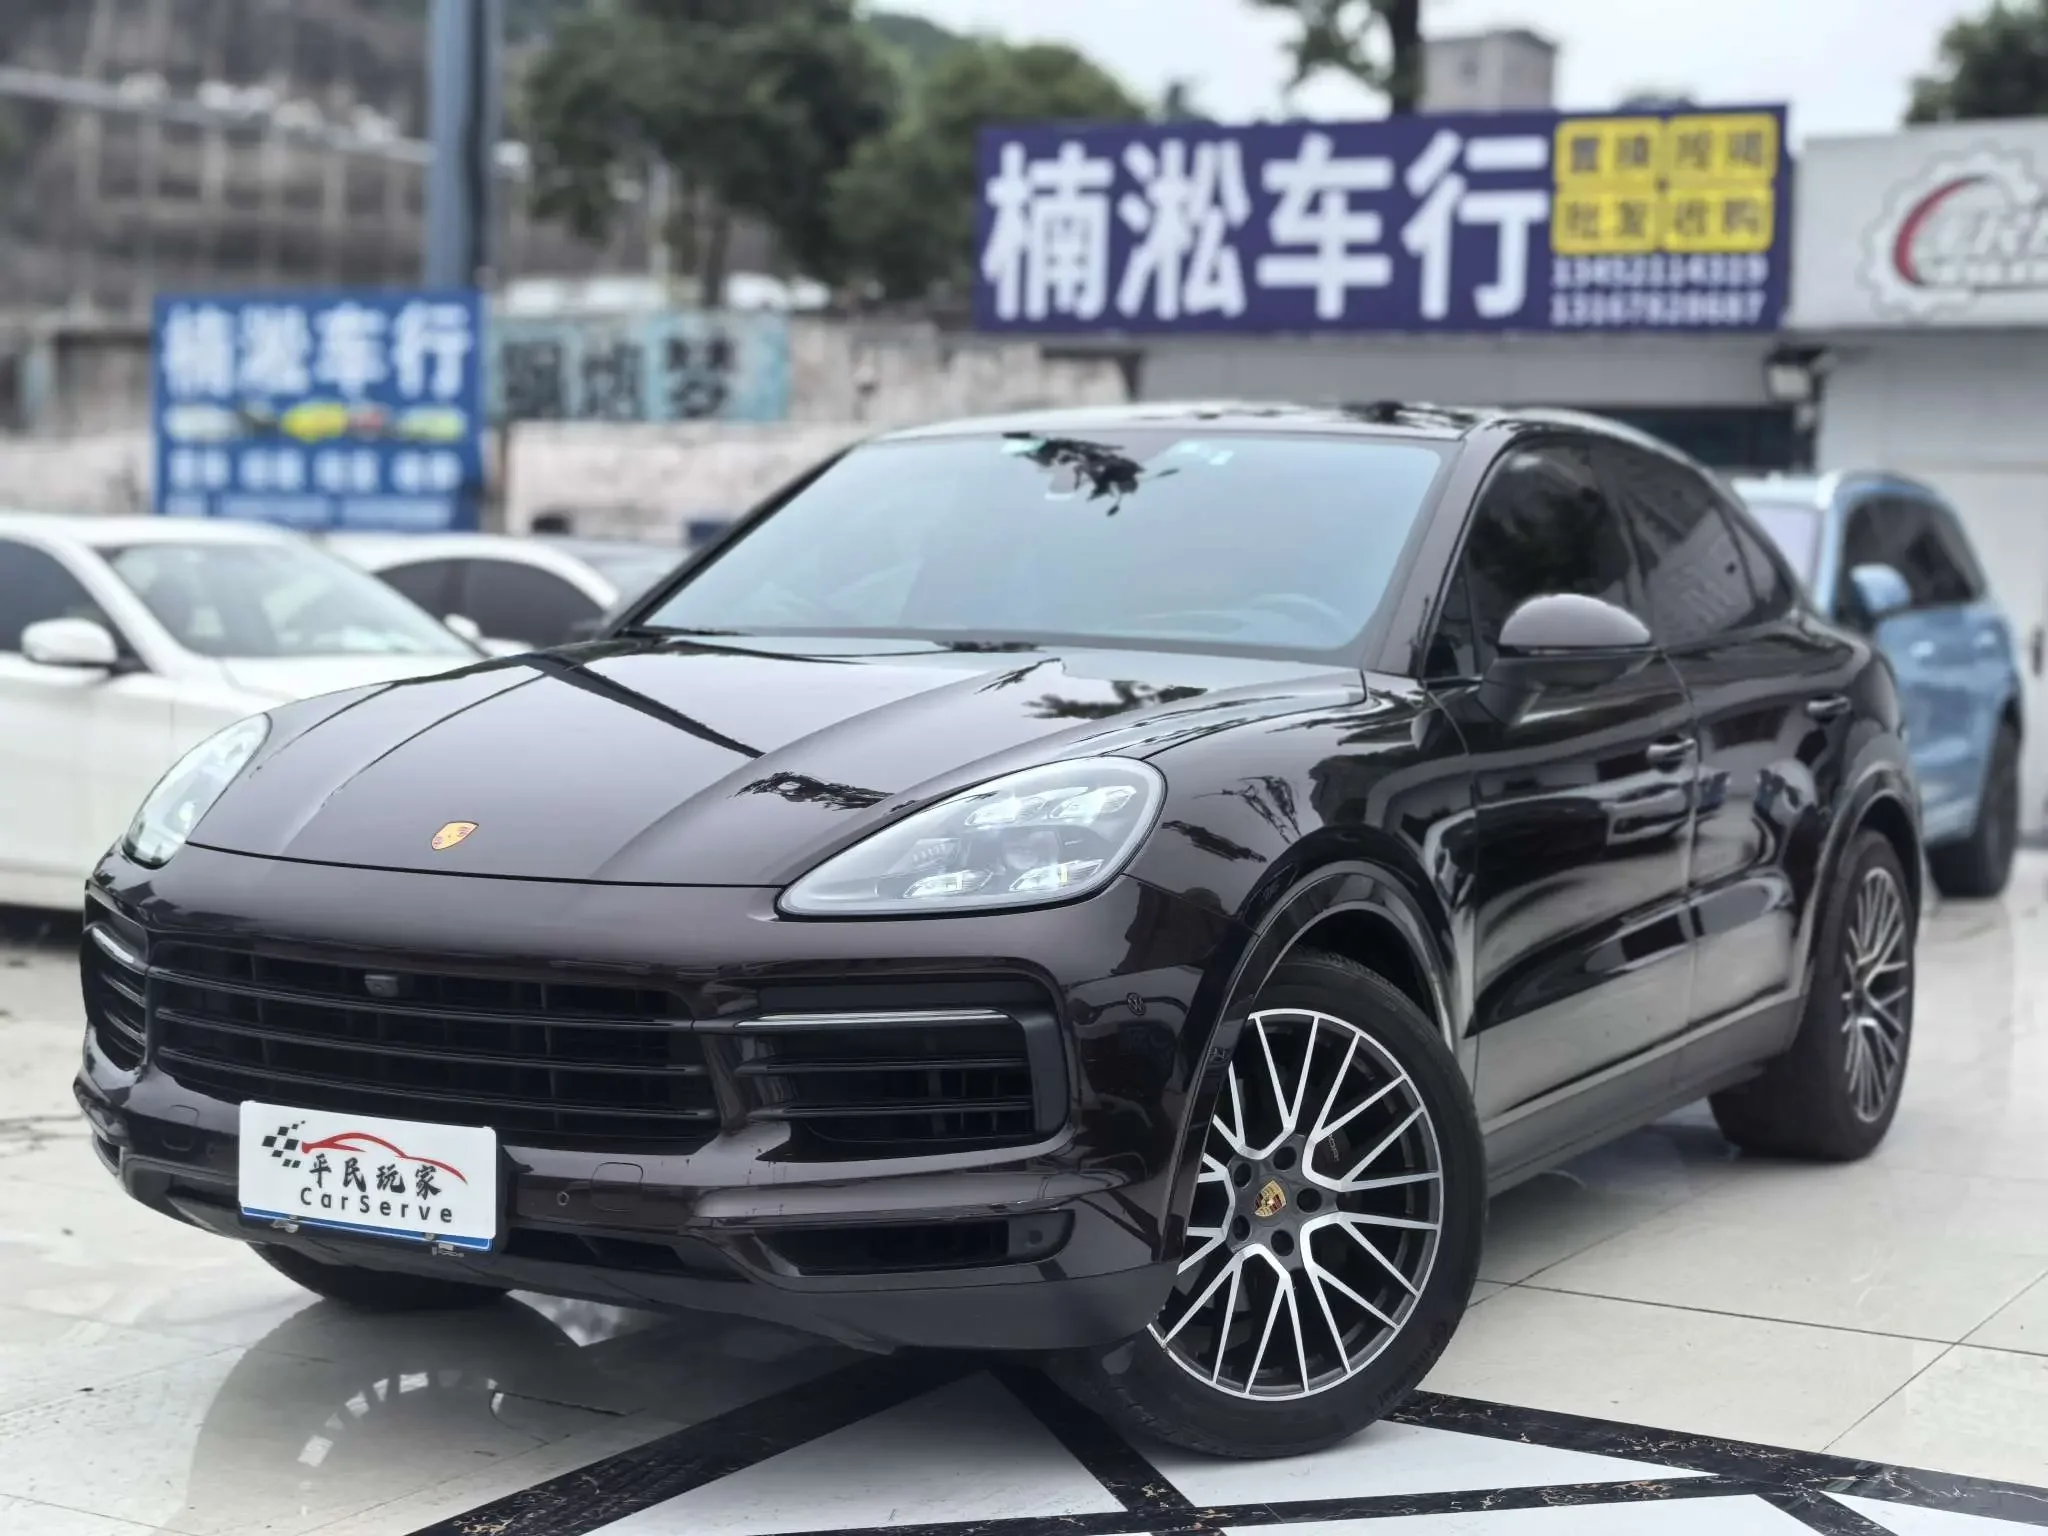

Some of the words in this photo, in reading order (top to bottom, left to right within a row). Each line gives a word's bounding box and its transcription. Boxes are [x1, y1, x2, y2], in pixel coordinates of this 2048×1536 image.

[981, 131, 1549, 321] 楠淞车行
[308, 1152, 442, 1200] 平民玩家
[299, 1186, 453, 1224] CarServe
